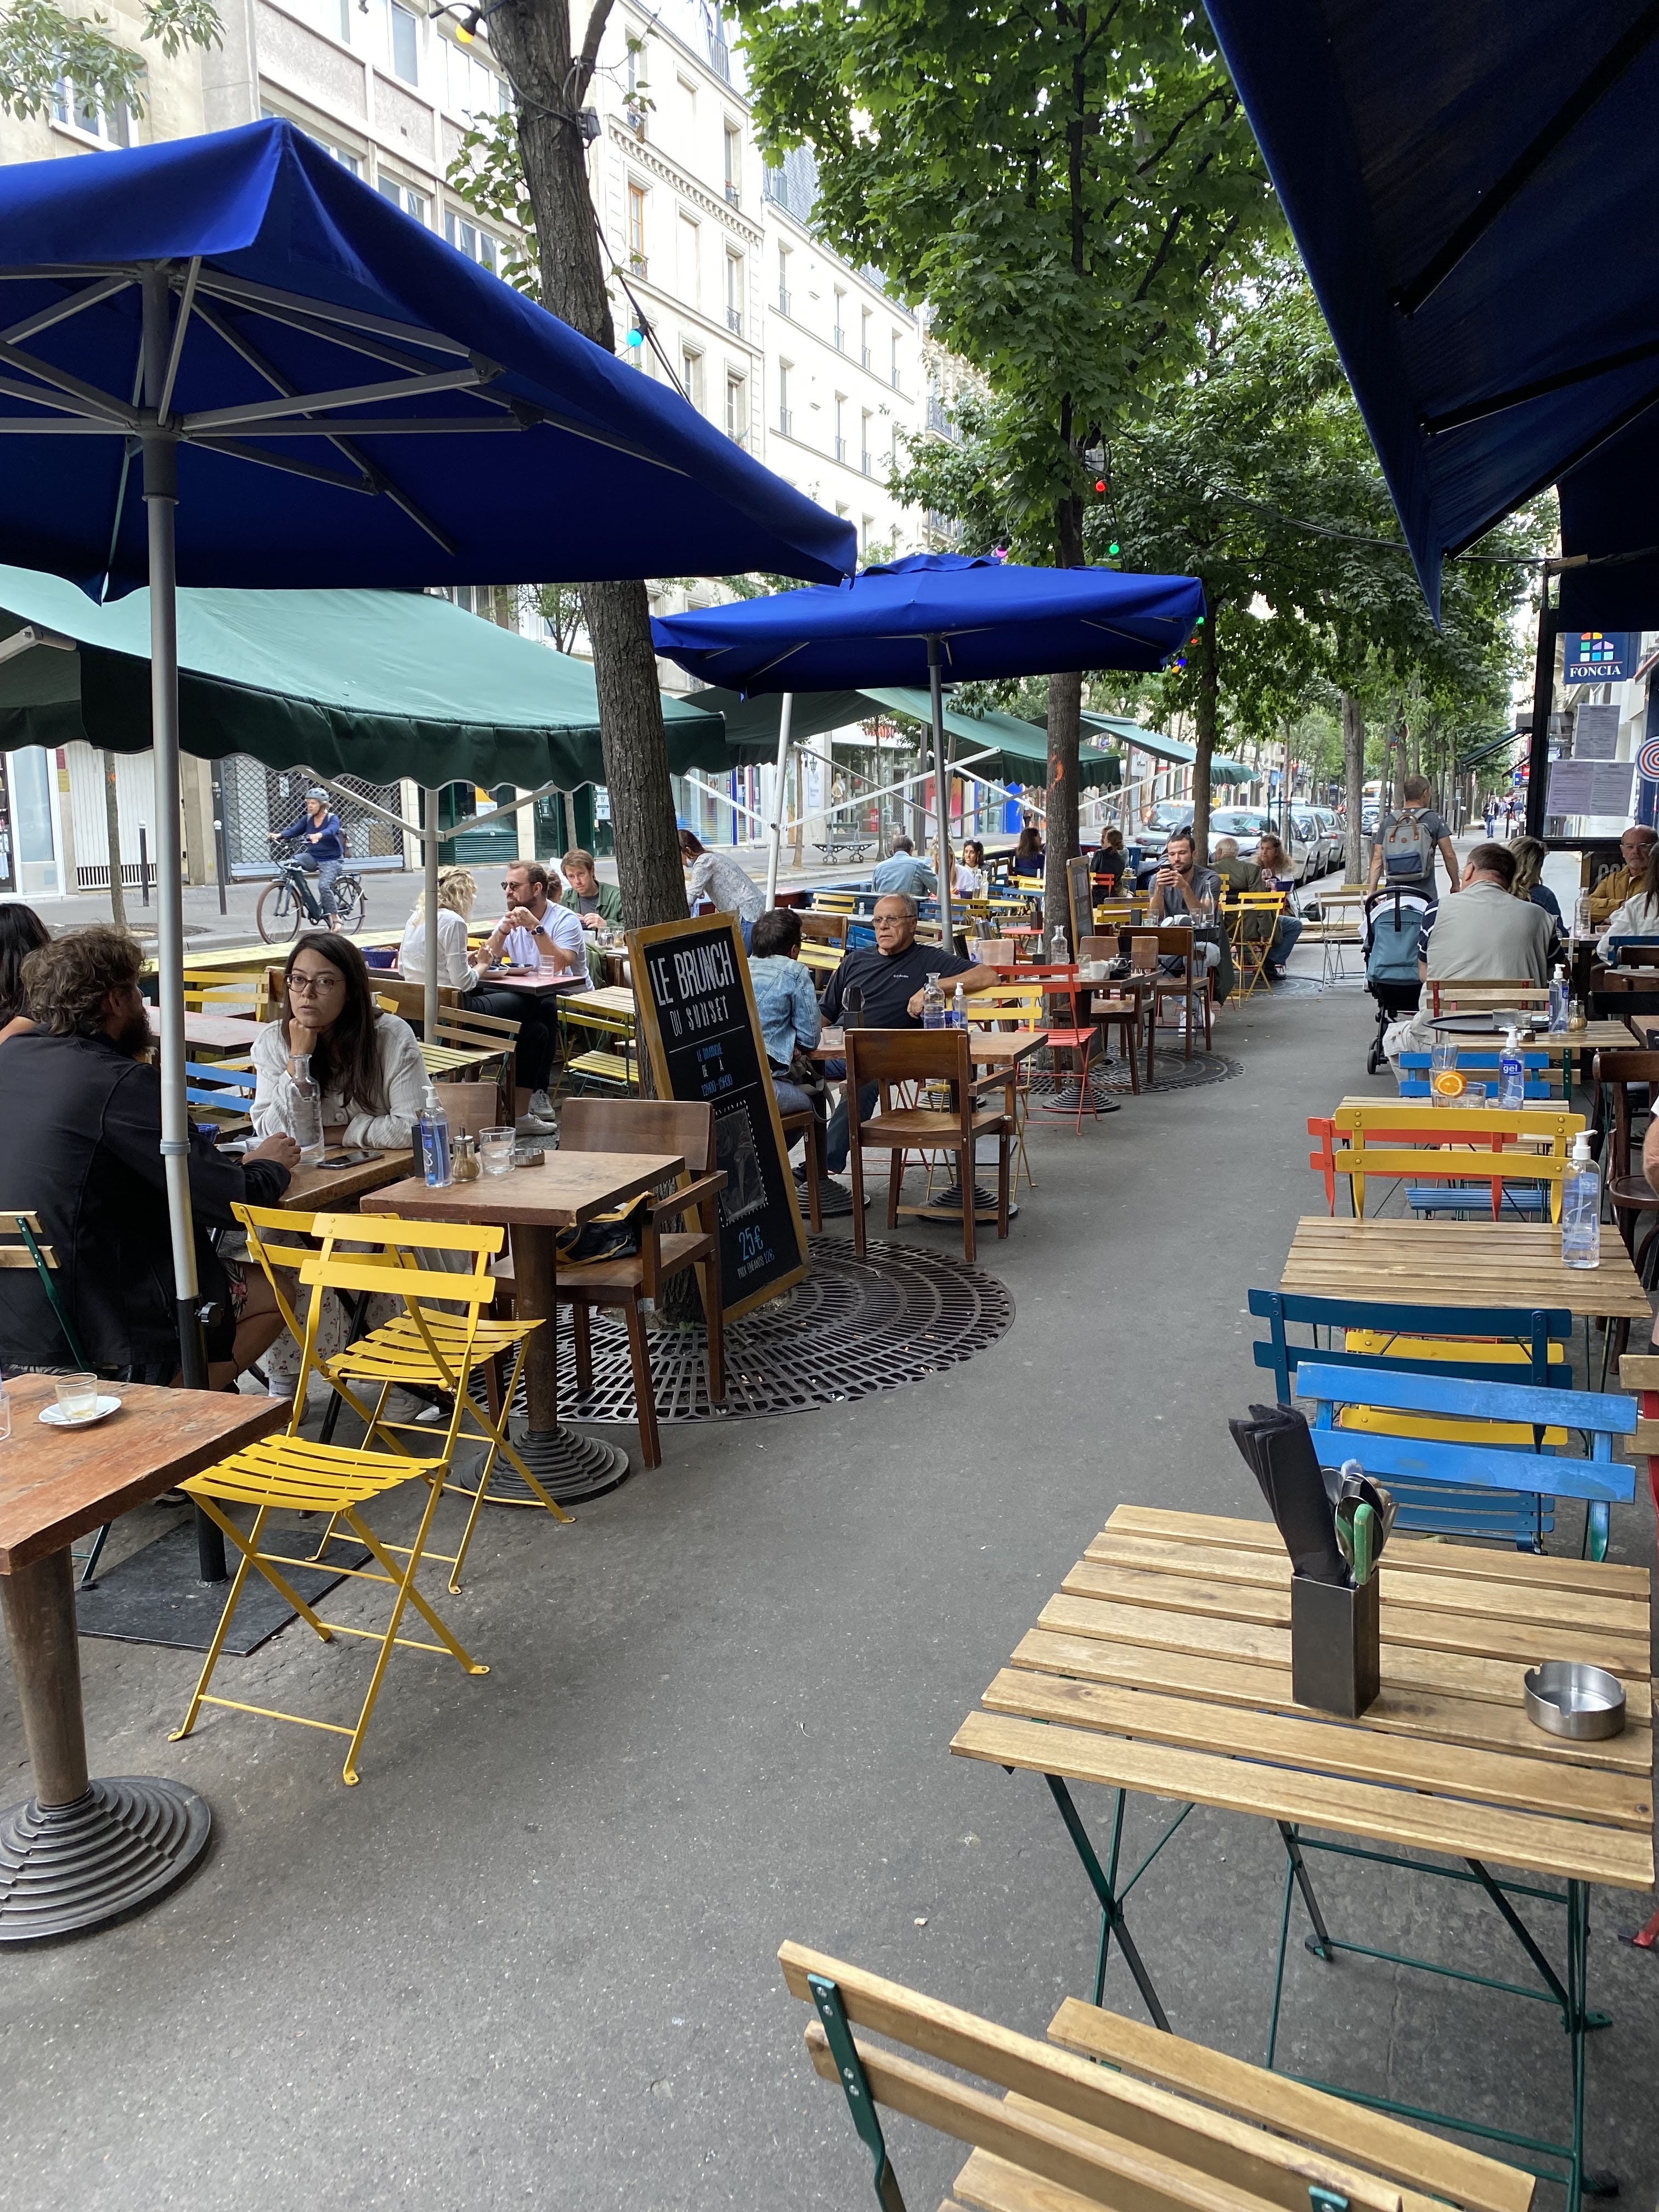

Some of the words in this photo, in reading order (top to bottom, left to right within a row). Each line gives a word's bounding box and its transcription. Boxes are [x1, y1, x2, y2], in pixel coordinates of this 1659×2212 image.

[1570, 665, 1622, 678] FONCIA
[650, 957, 674, 1006] LE
[673, 940, 735, 1000] BRUNCH
[669, 1009, 682, 1037] DU
[686, 995, 729, 1031] SUNSET
[1503, 1064, 1518, 1074] gel
[738, 1225, 764, 1261] 25€
